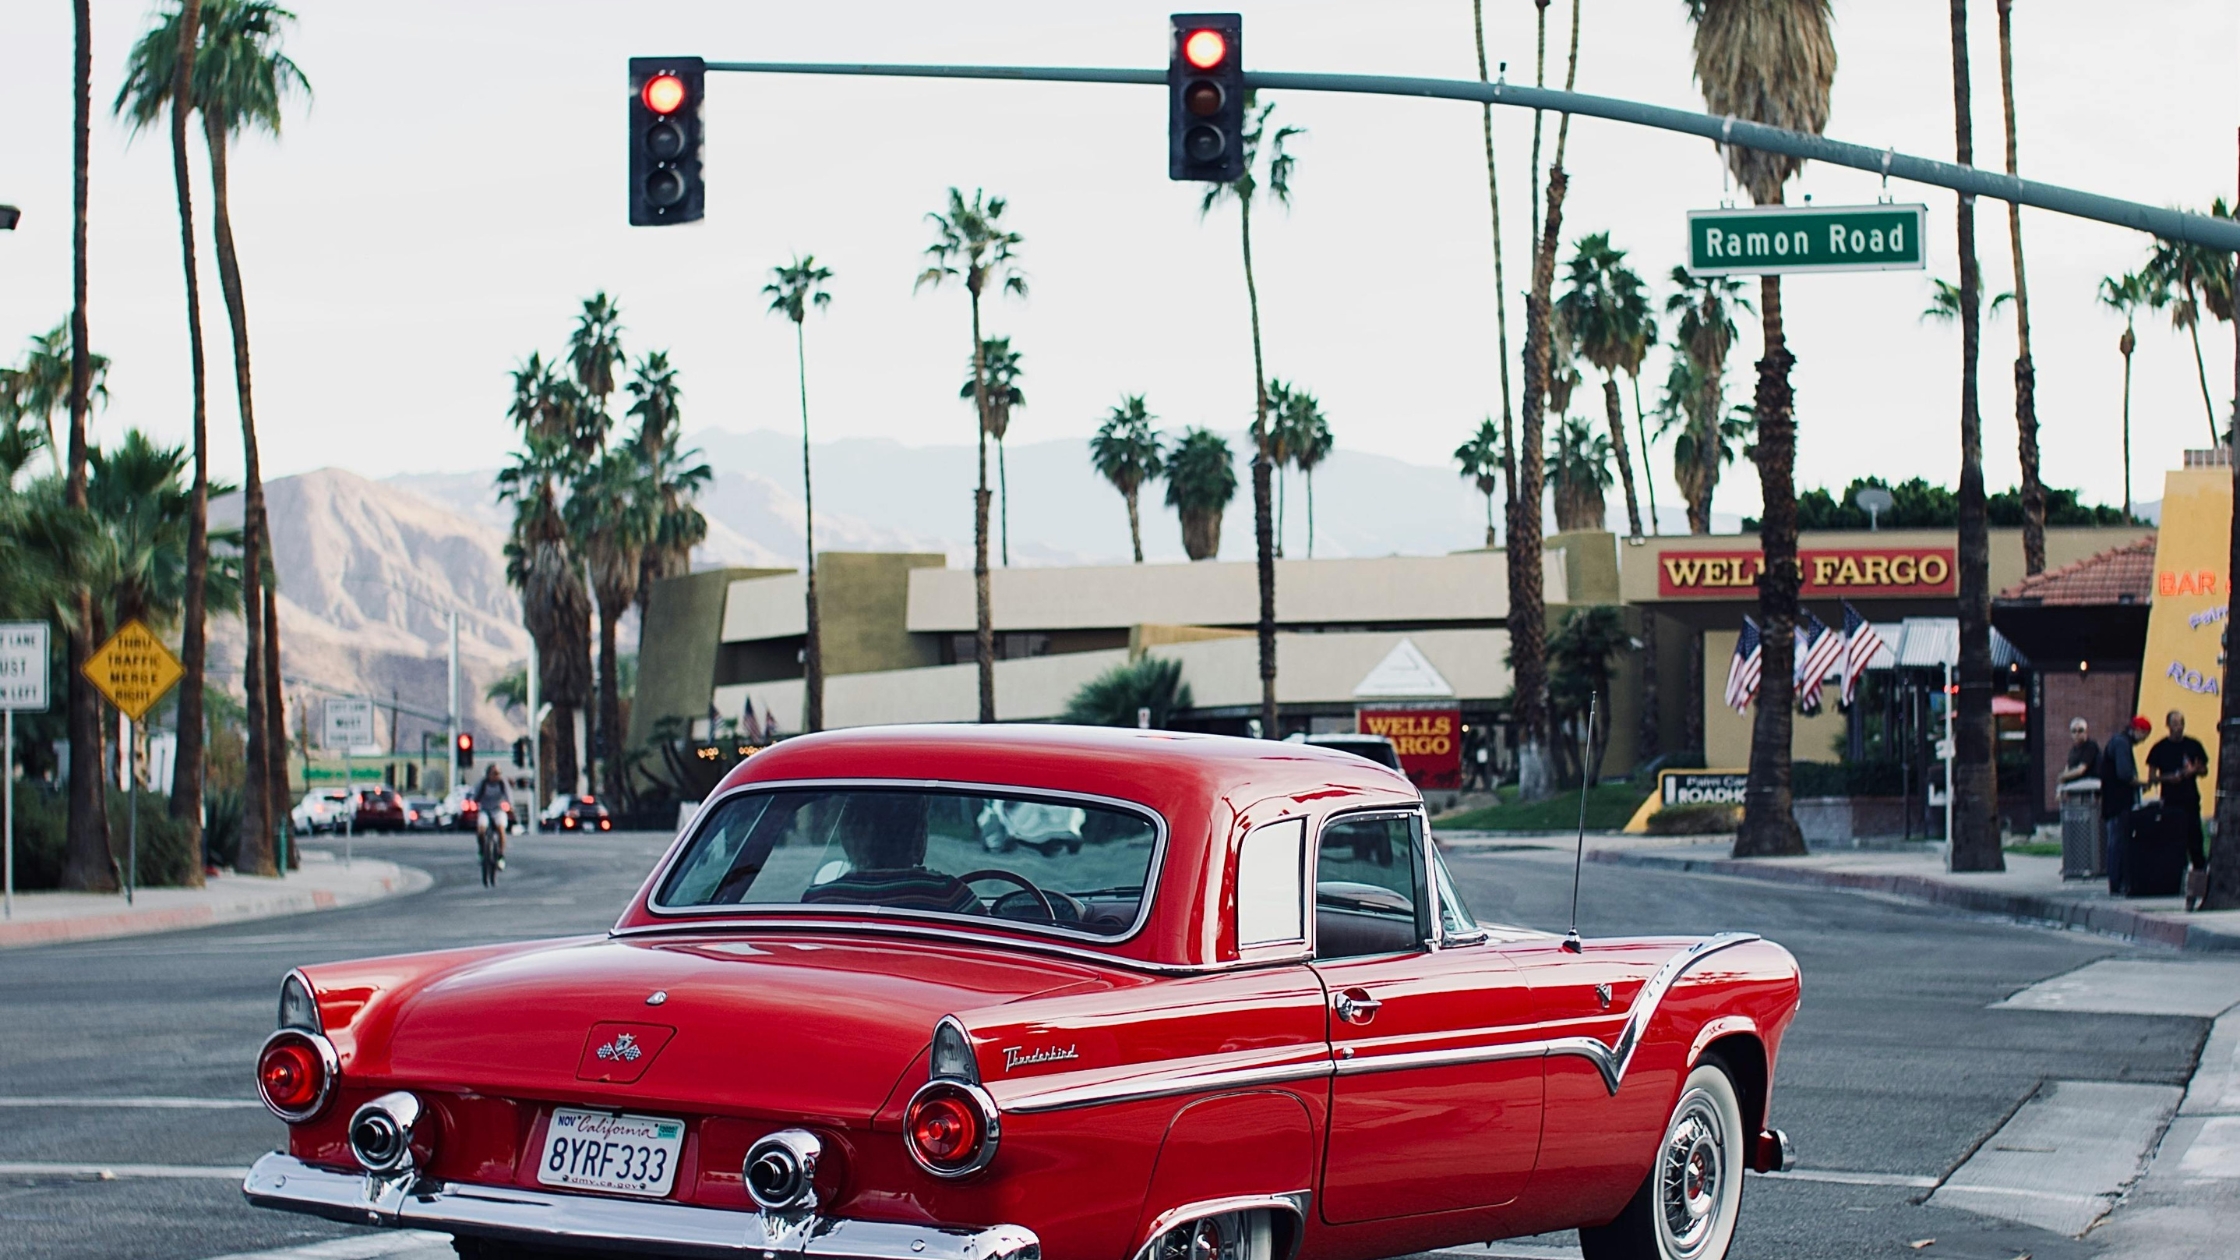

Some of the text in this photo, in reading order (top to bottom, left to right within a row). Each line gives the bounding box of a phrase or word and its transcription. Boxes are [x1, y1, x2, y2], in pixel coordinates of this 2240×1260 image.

[1706, 222, 1904, 258] Ramon Road
[1662, 554, 1949, 587] WEL FARGO
[2159, 571, 2216, 596] BAR
[0, 655, 26, 677] UST
[108, 652, 160, 668] TRAFFIC
[110, 671, 158, 686] MERGE
[1366, 716, 1451, 736] WELLS
[1391, 736, 1450, 755] ARGO
[1002, 1043, 1079, 1073] Thunderbird
[558, 1115, 577, 1127] NOV
[577, 1114, 658, 1140] California
[549, 1137, 667, 1183] 8YRF333
[570, 1177, 638, 1190] dmv.ca.gov
